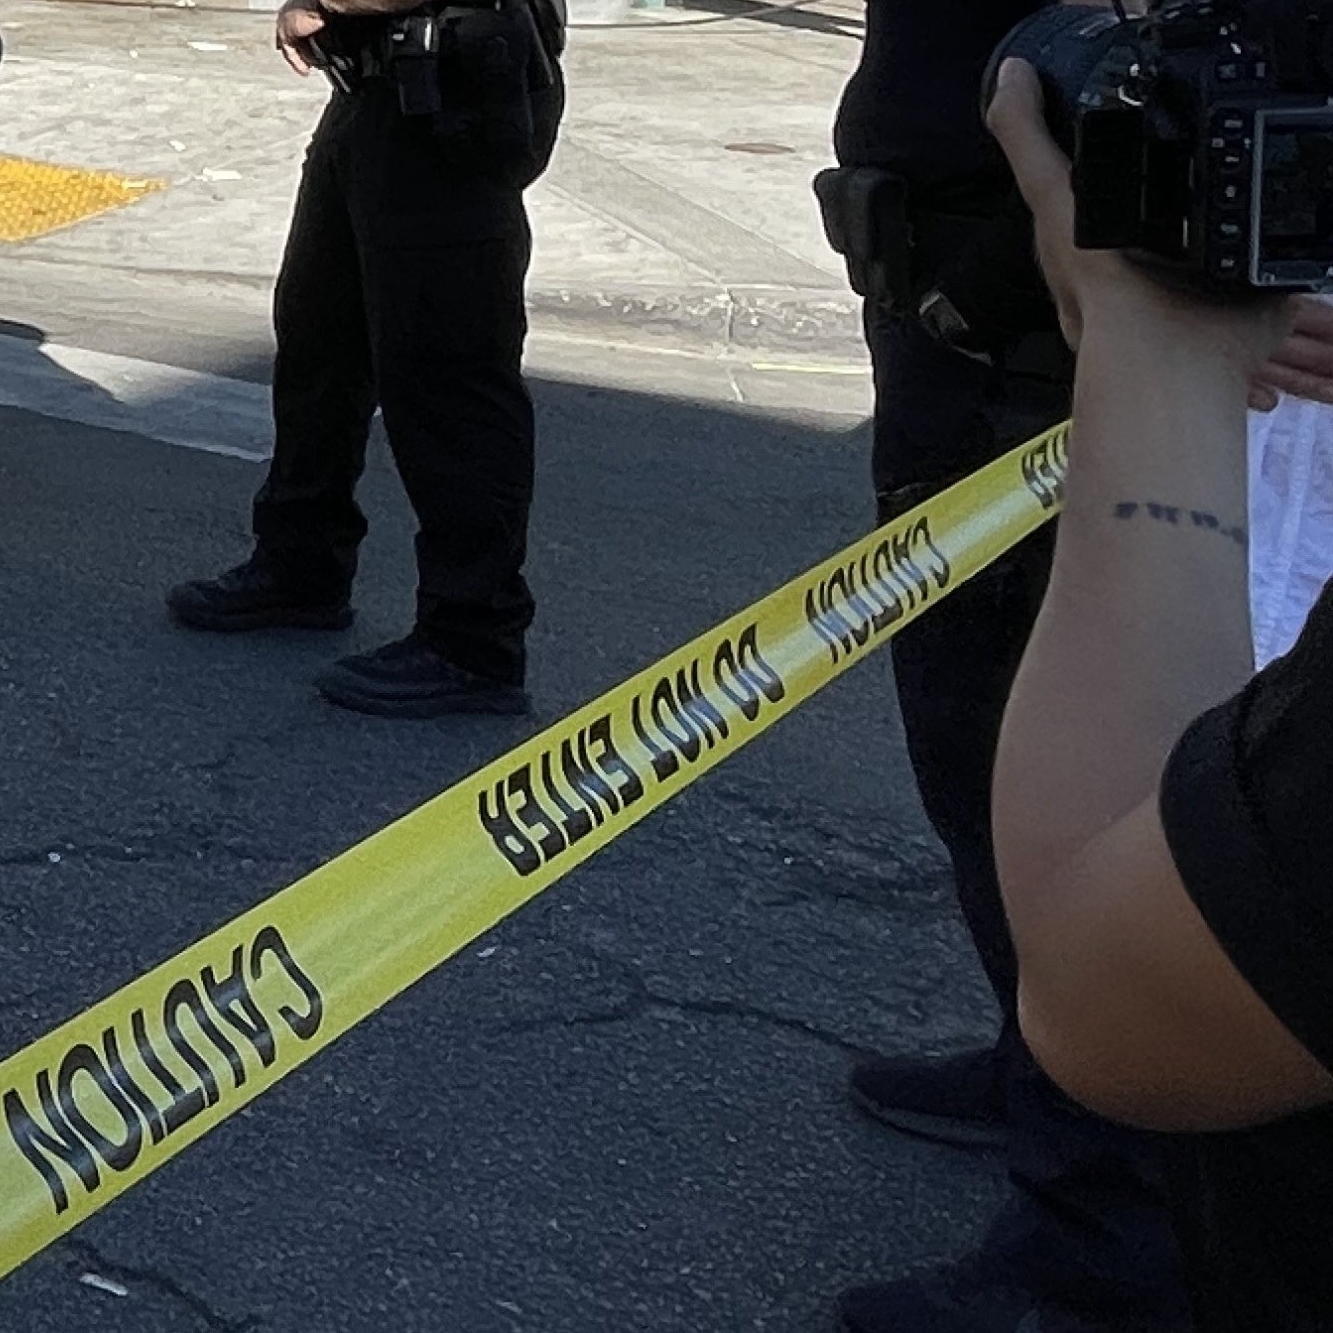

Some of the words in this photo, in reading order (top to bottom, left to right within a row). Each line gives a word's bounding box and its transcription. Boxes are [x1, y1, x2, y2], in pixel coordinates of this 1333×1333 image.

[805, 516, 950, 664] CAUTION
[631, 658, 729, 783] NOT
[712, 622, 786, 721] DO
[478, 713, 644, 876] ENTER
[2, 925, 323, 1215] CAUTION
